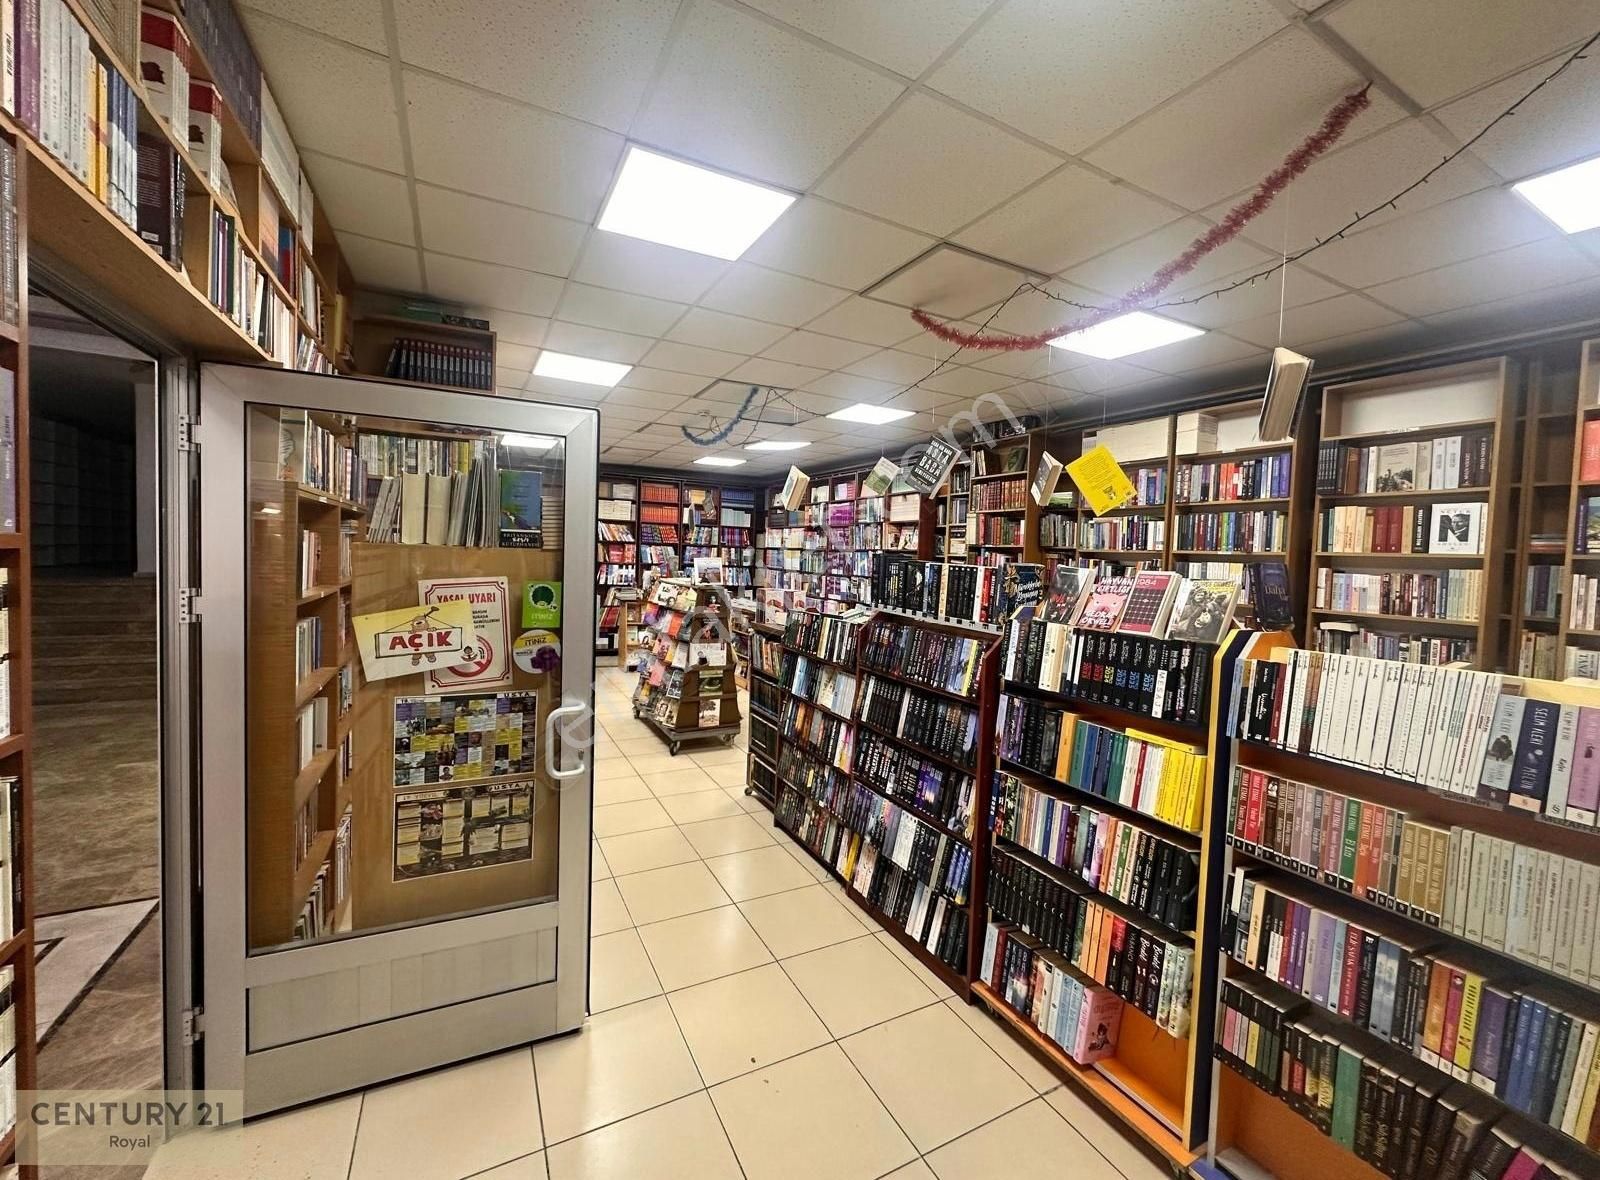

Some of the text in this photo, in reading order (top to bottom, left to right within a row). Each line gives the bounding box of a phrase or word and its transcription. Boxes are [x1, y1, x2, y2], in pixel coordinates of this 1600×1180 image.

[926, 445, 950, 465] ASLA
[1101, 576, 1134, 586] HAYVAN
[468, 592, 496, 604] UYARI
[1080, 617, 1114, 625] ORWELL
[389, 631, 452, 652] AÇIK
[1154, 672, 1165, 706] MESAJ
